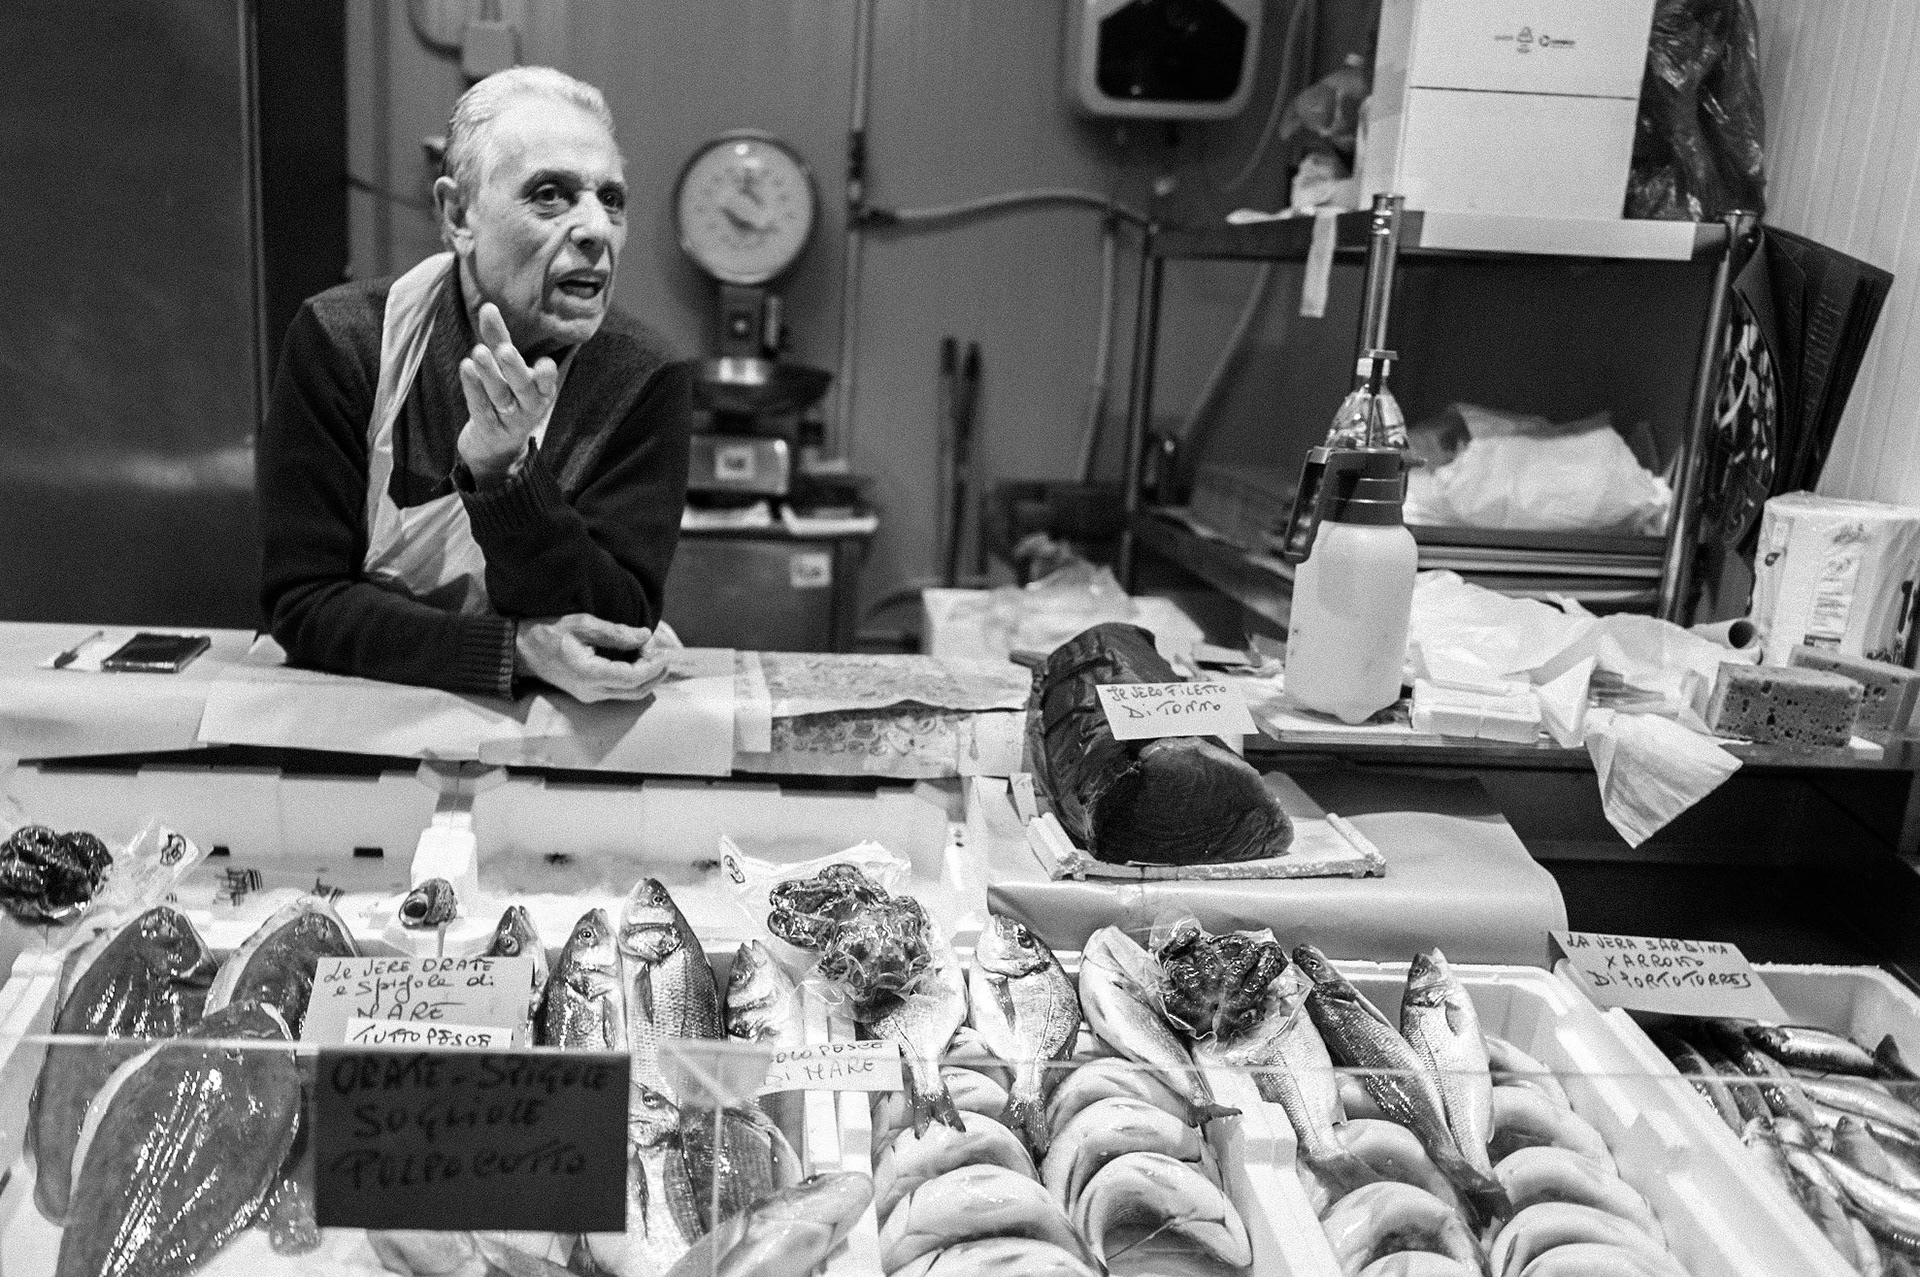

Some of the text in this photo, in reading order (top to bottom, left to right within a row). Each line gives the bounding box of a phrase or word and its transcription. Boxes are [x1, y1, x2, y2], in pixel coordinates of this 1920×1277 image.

[1164, 684, 1227, 698] FILETTO
[1596, 936, 1637, 950] VERA
[324, 960, 352, 983] Le
[421, 957, 495, 972] ORATE
[333, 984, 347, 997] e
[466, 972, 494, 986] di
[353, 1024, 421, 1044] TUTTO
[770, 1049, 812, 1064] OLO
[330, 1053, 447, 1095] ORATE
